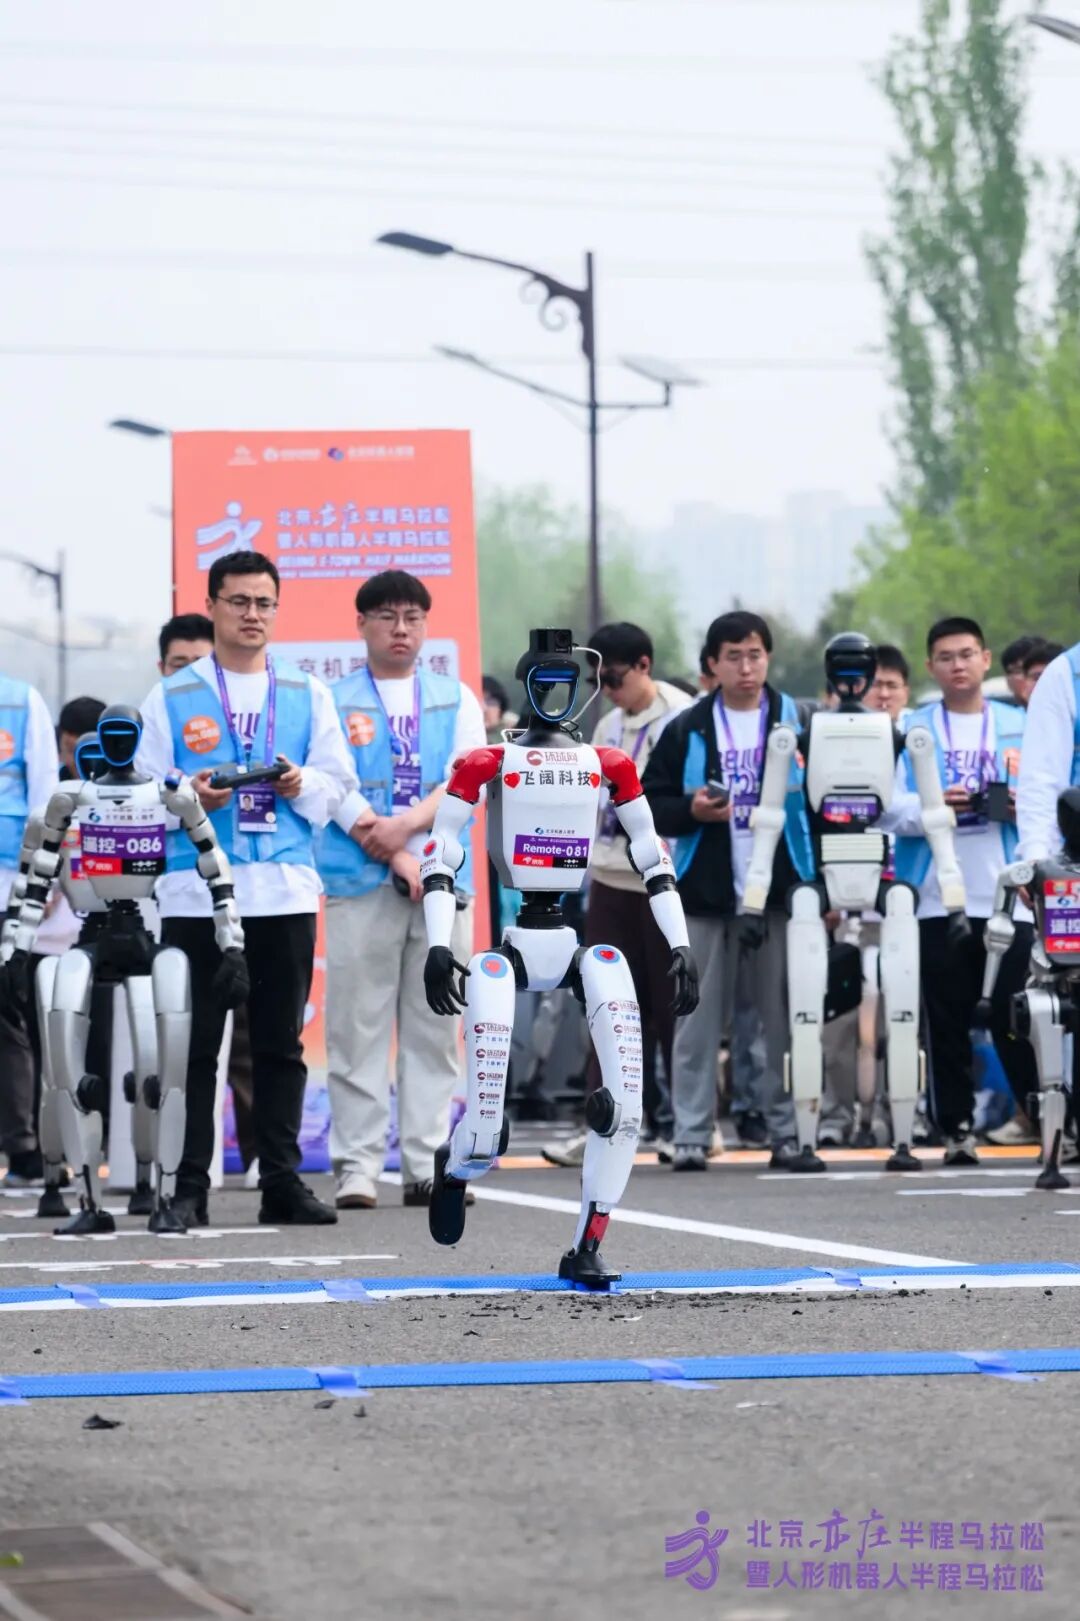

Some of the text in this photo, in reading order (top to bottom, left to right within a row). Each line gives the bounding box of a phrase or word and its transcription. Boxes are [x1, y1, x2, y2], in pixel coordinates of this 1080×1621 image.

[519, 770, 590, 786] 飞阔科技
[523, 843, 588, 857] Remote-081
